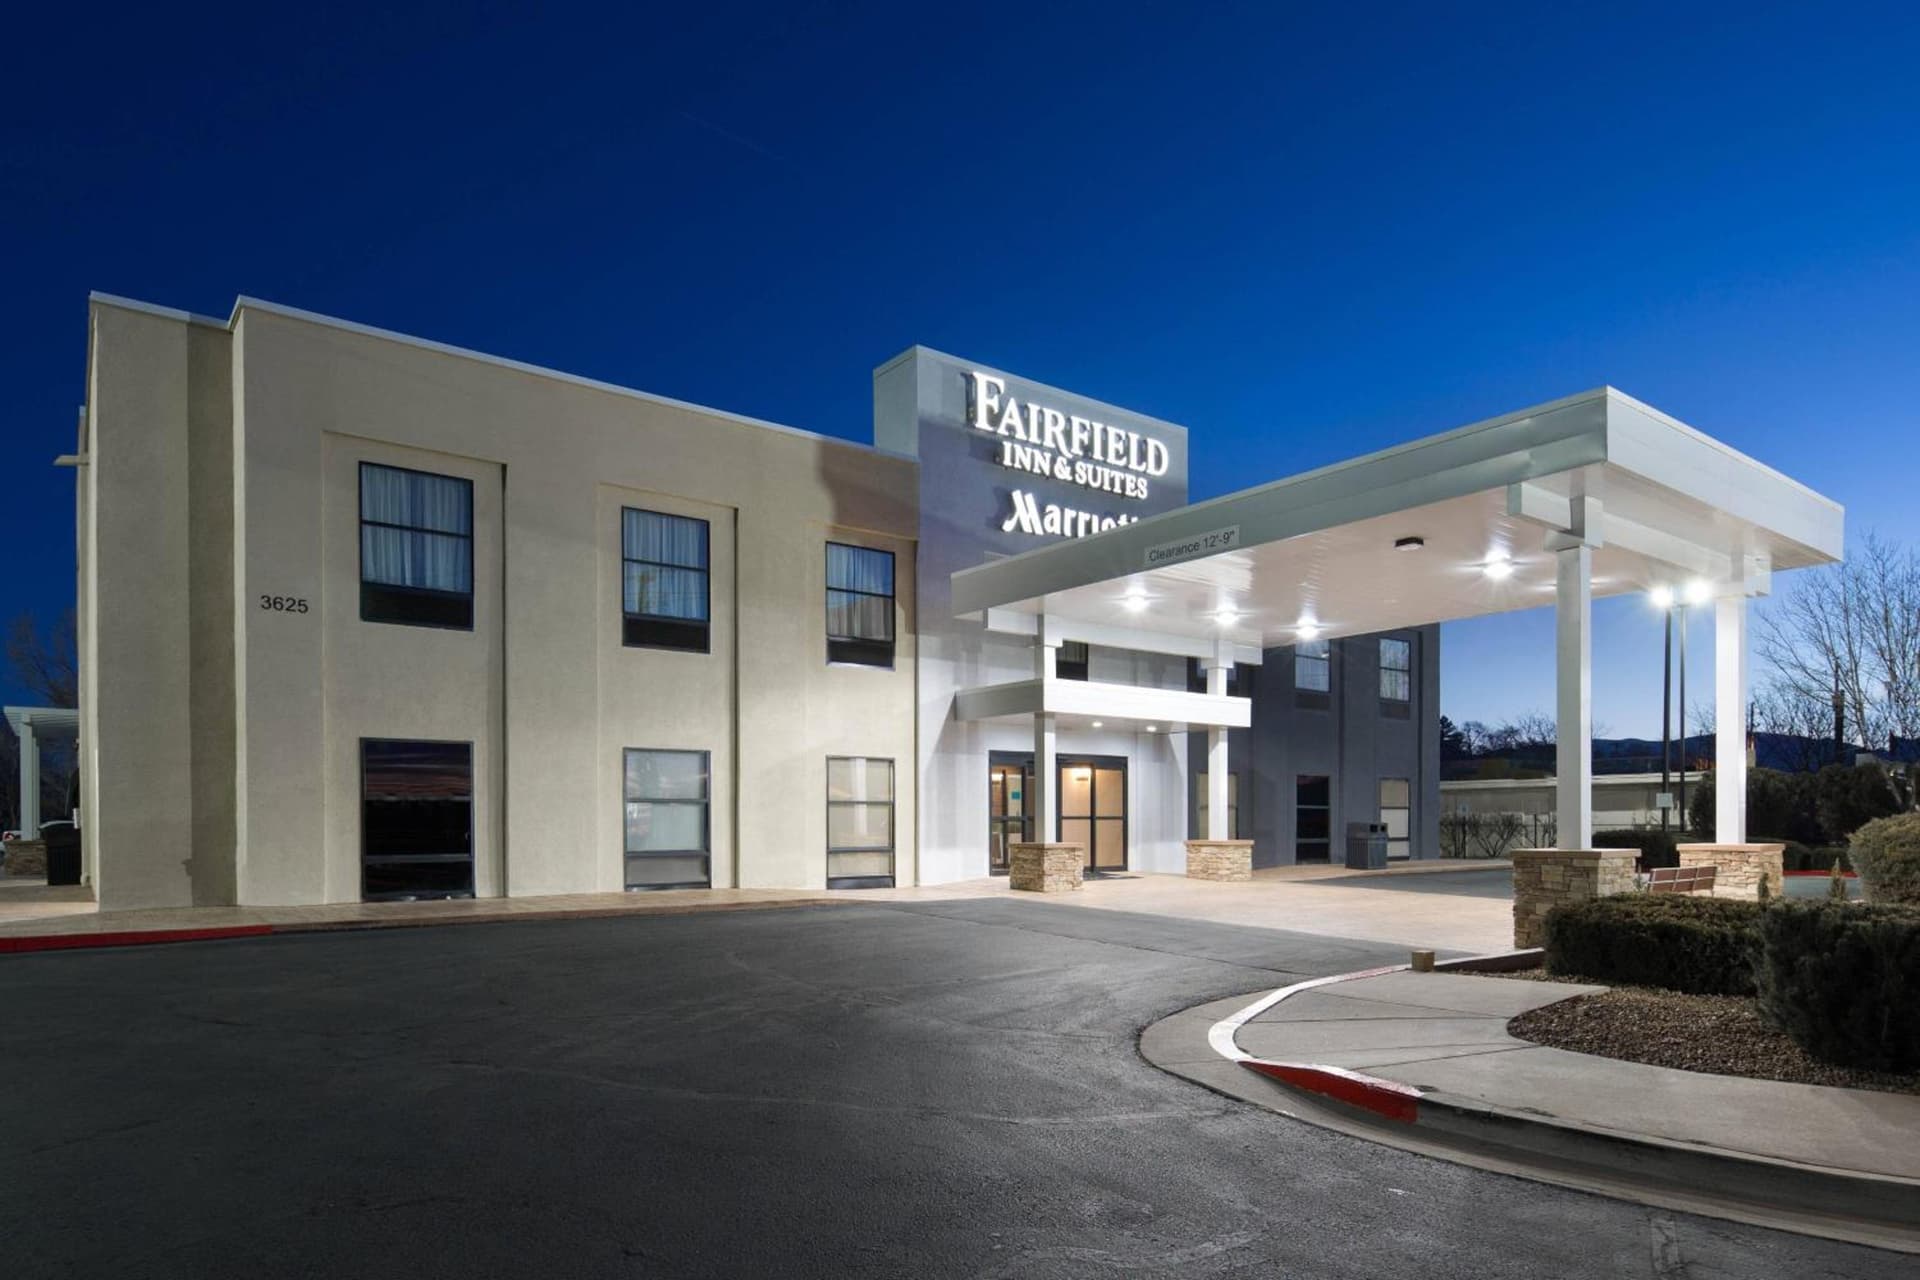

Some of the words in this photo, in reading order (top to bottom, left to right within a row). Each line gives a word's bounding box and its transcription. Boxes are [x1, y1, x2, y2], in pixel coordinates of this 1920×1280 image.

[973, 371, 1170, 477] FAIRFIELD
[1002, 441, 1051, 477] INN
[1053, 457, 1073, 481] &
[1075, 464, 1148, 500] SUITES
[1002, 489, 1139, 538] Marrio
[1148, 541, 1200, 562] Clearance
[260, 595, 309, 614] 3625
